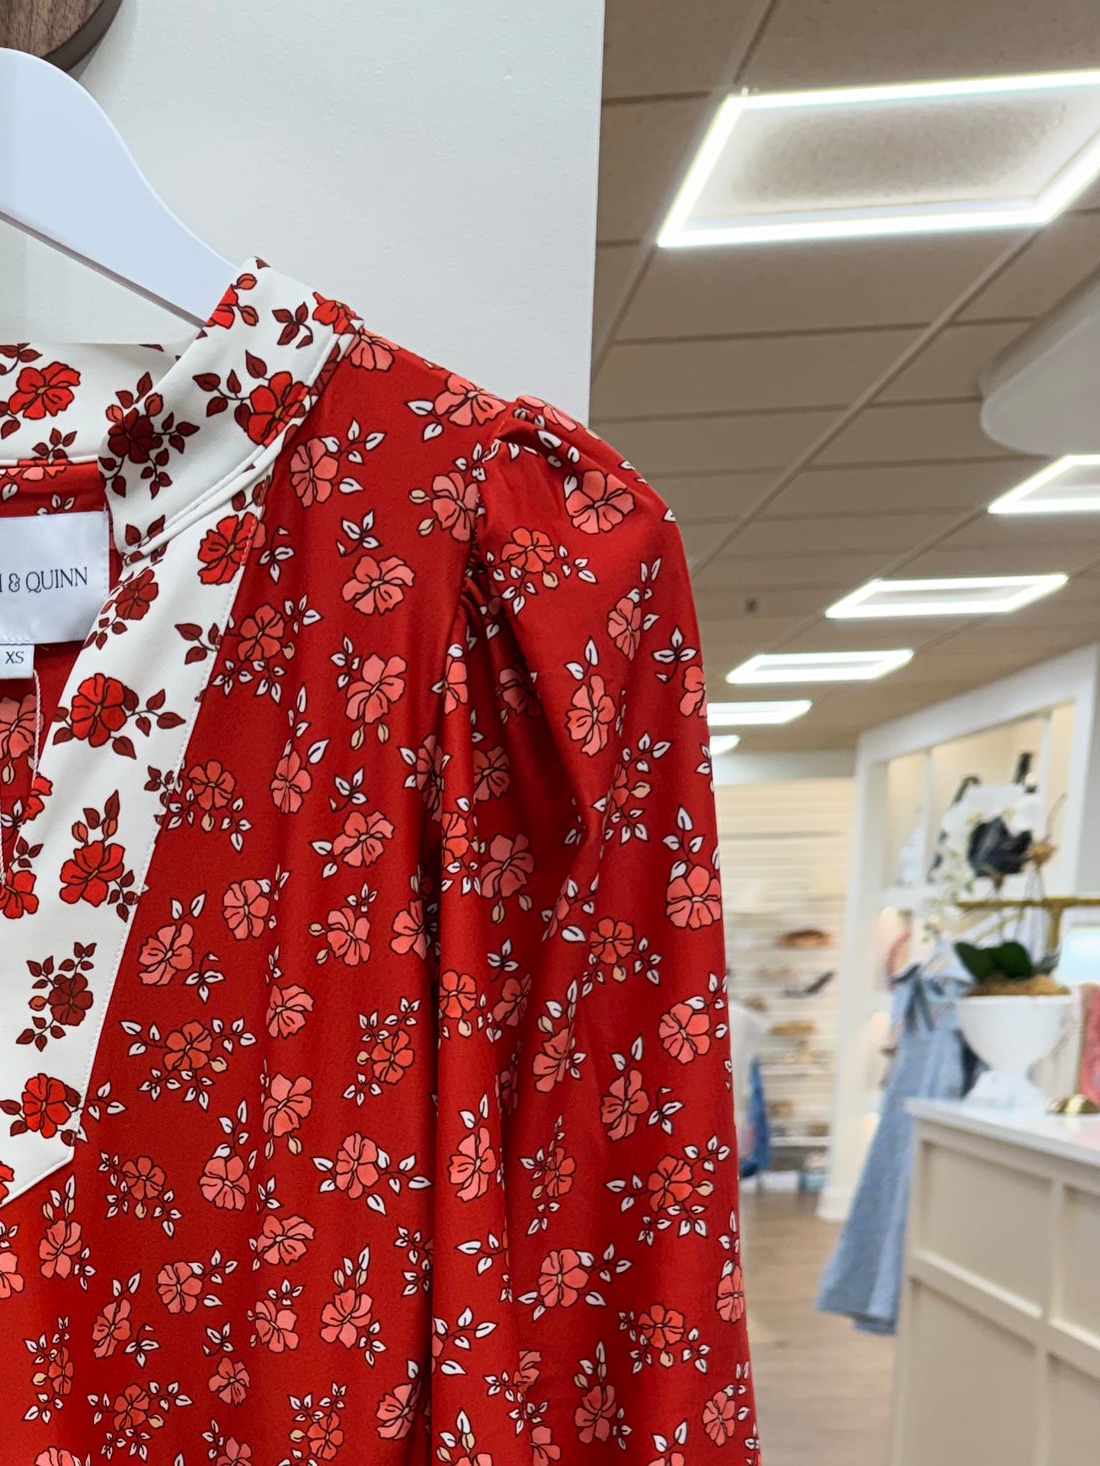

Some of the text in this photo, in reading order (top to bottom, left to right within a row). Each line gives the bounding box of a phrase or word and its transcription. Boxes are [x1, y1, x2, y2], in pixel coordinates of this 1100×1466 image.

[8, 573, 21, 593] &
[25, 567, 88, 593] QUINN
[5, 651, 25, 664] XS
